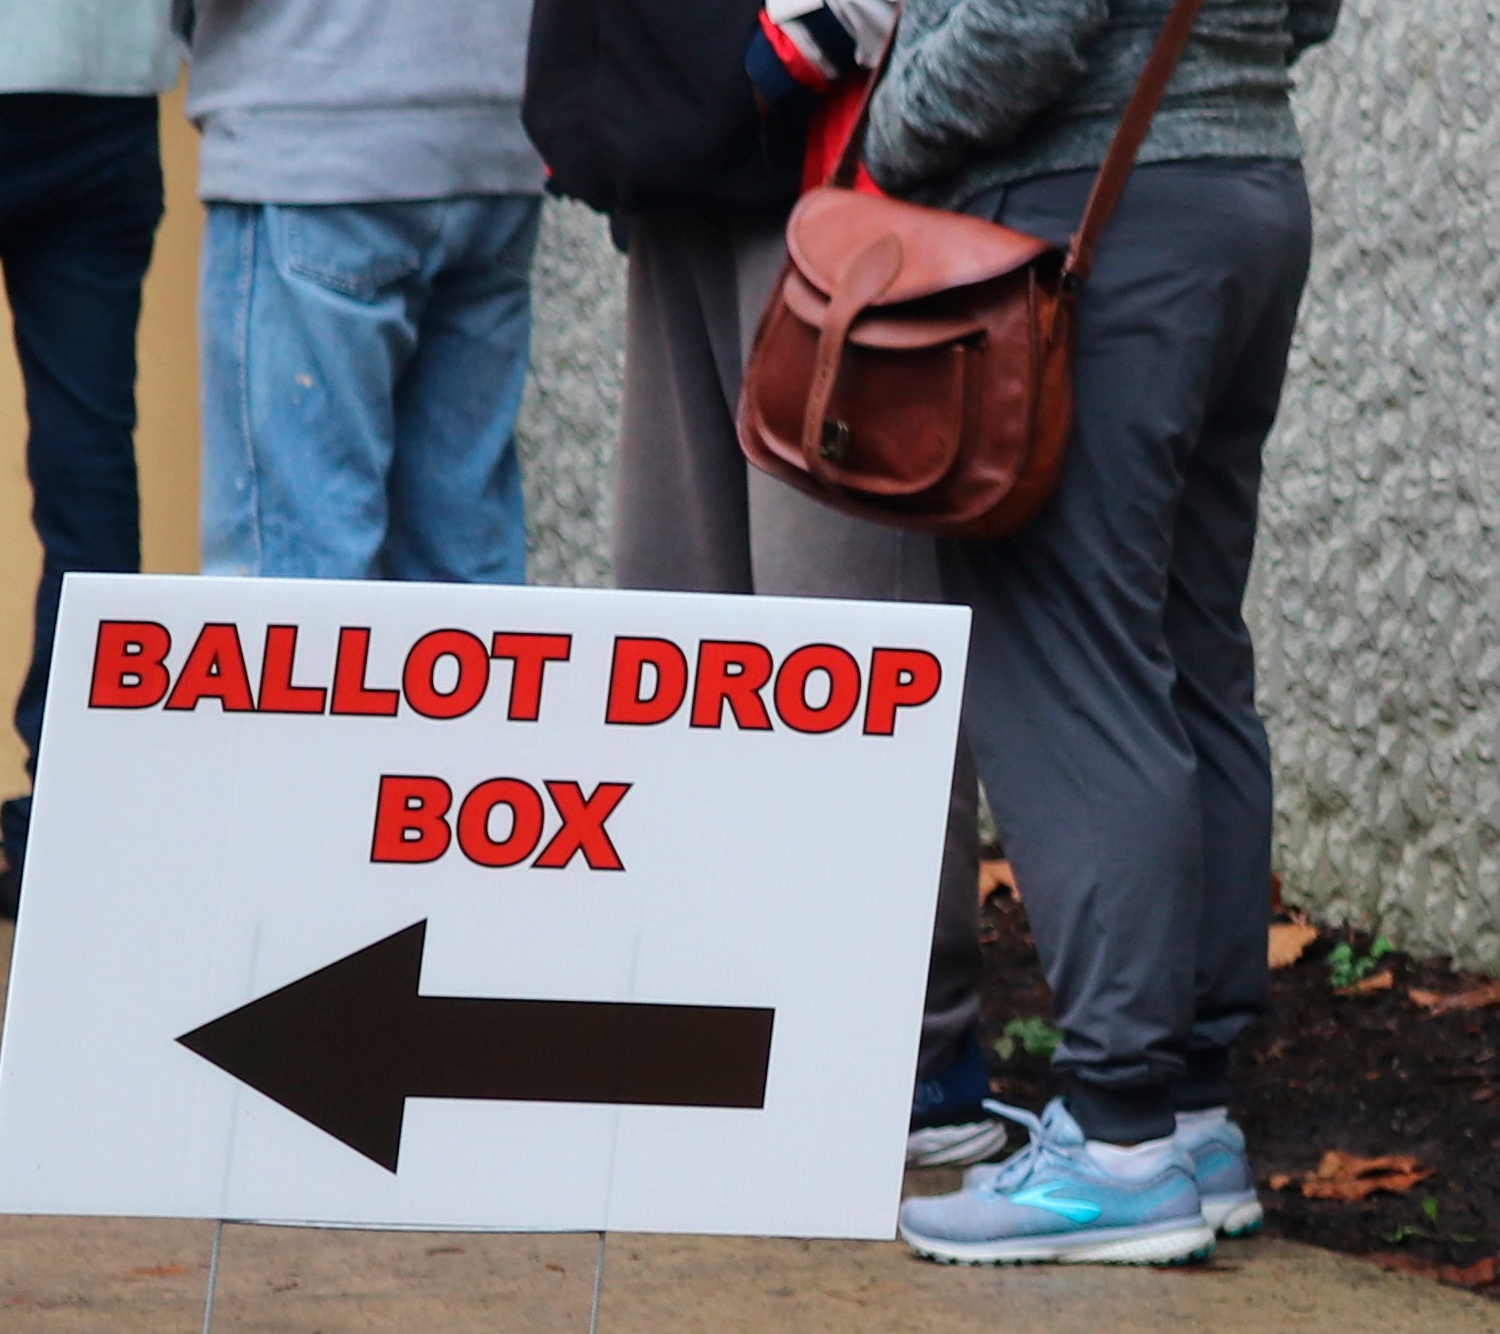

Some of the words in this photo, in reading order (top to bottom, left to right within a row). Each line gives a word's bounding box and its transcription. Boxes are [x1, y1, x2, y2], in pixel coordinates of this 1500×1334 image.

[87, 619, 574, 723] BALLOT
[603, 634, 944, 738] DROP
[369, 773, 632, 872] BOX
